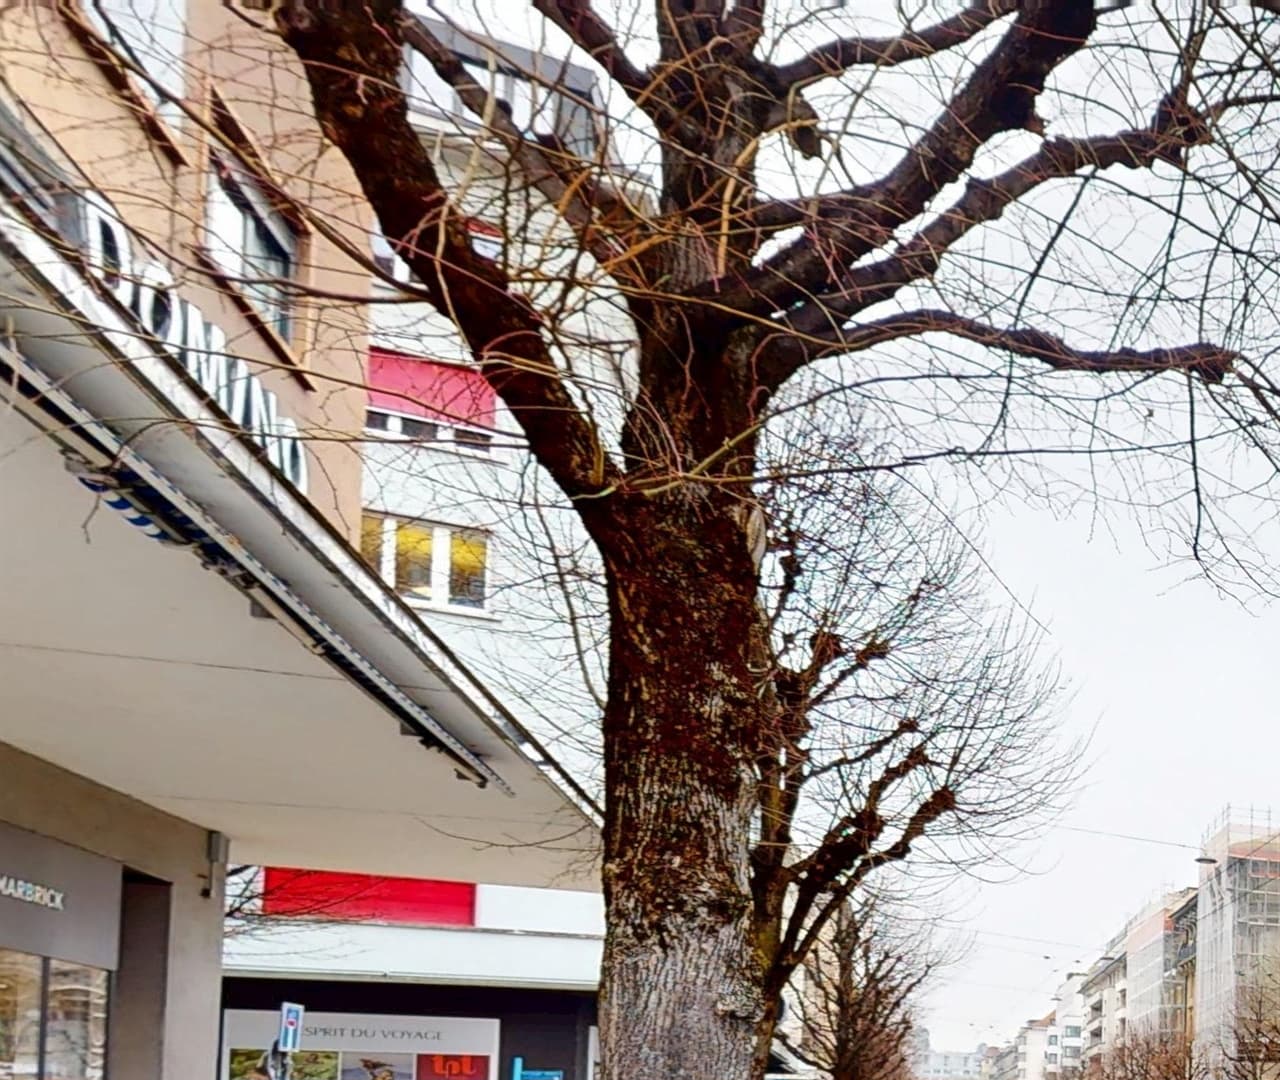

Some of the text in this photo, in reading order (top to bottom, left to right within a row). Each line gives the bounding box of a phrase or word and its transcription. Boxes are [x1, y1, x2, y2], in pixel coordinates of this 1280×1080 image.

[304, 1026, 444, 1041] SPRIT DU VOYAGE
